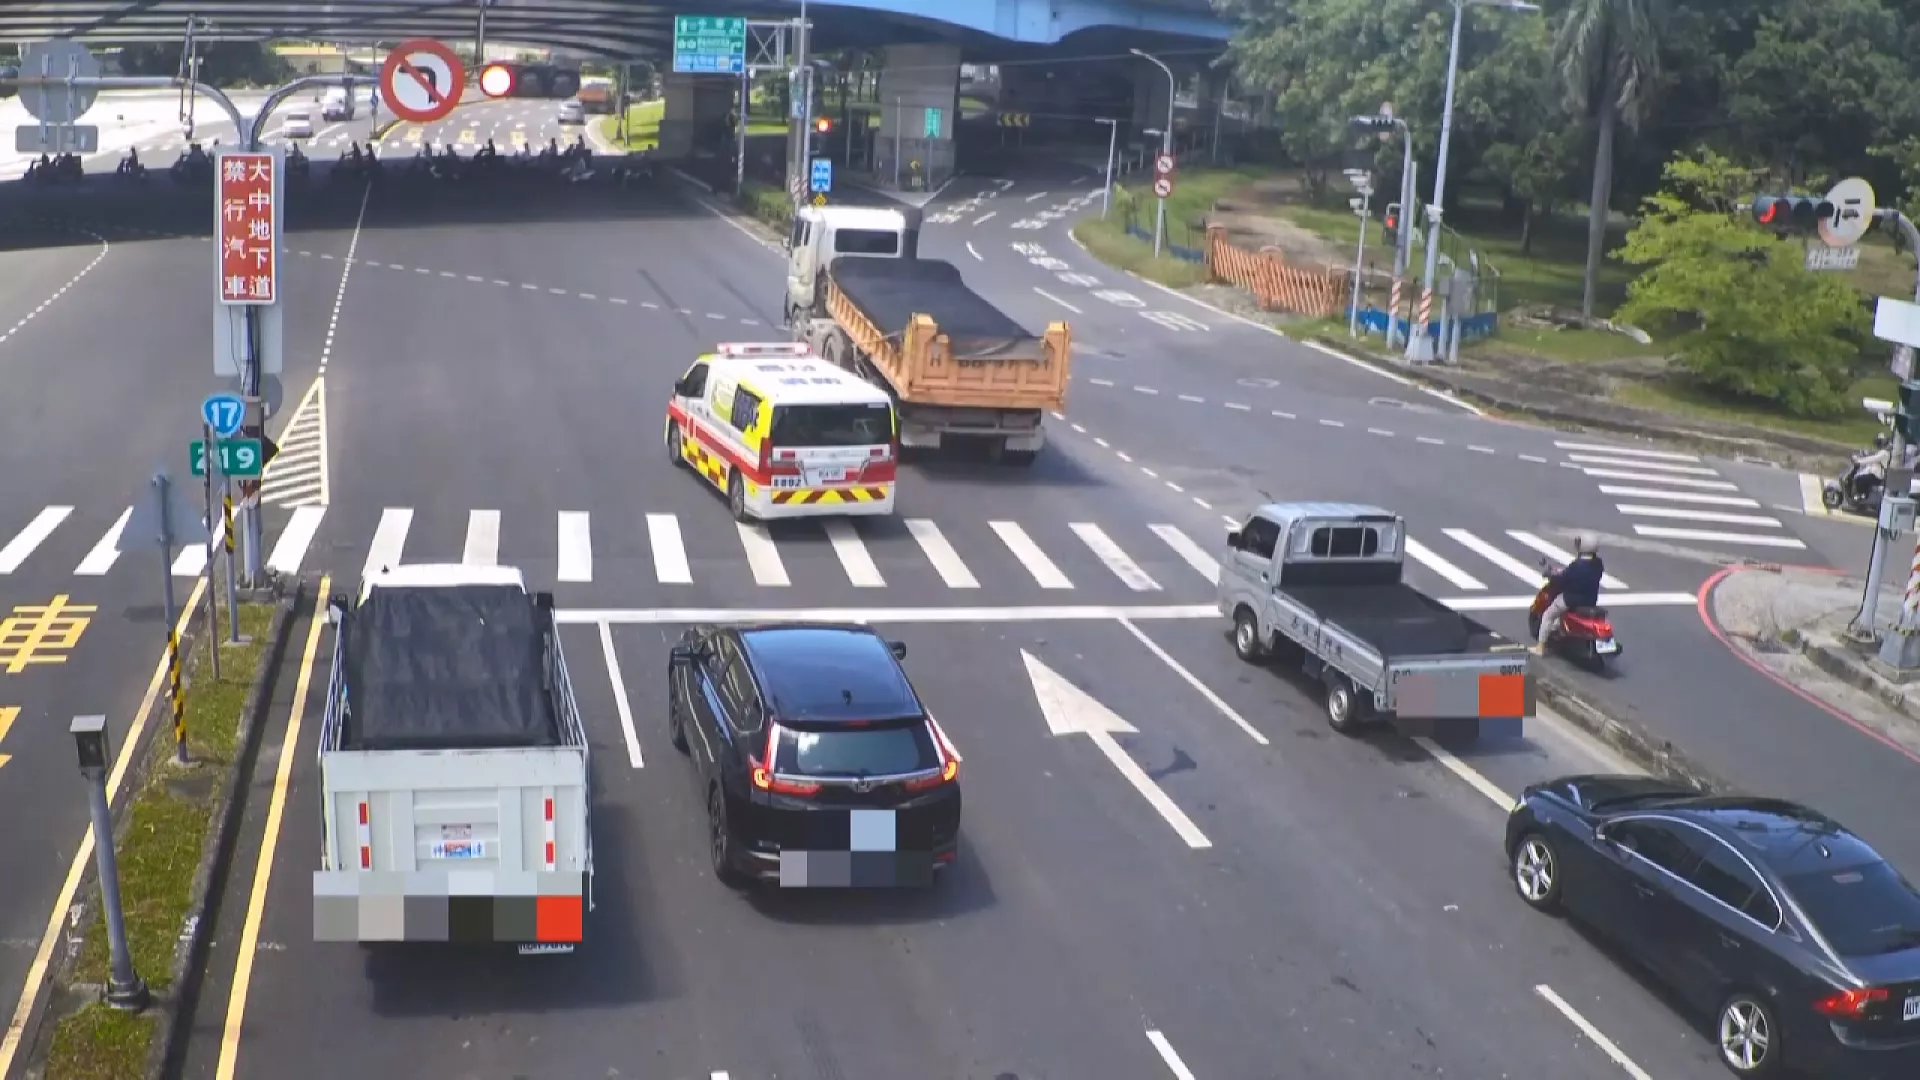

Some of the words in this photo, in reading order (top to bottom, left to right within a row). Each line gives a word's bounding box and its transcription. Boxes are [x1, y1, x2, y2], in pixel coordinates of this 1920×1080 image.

[224, 160, 246, 298] 禁行汽車
[249, 160, 270, 297] 大中地下道
[211, 402, 238, 427] 17
[0, 594, 98, 673] 車
